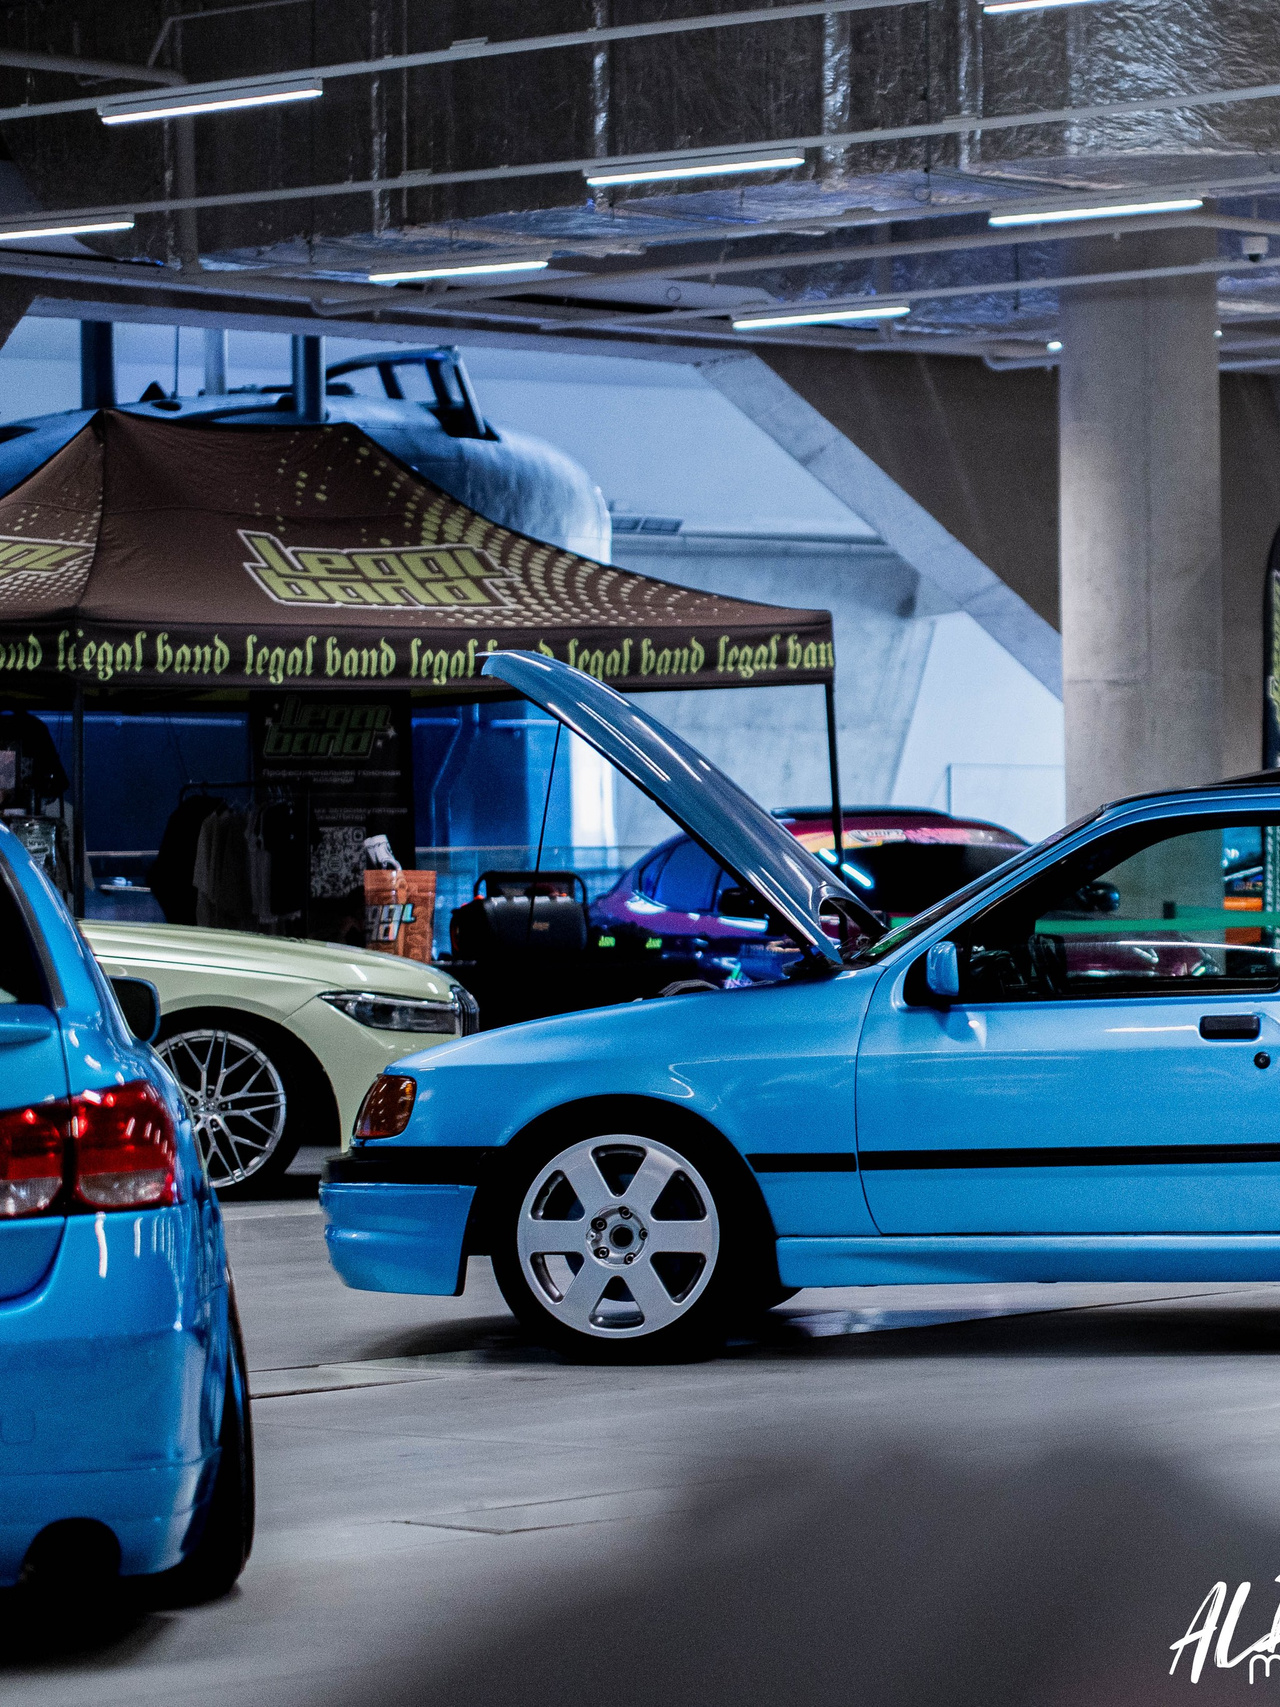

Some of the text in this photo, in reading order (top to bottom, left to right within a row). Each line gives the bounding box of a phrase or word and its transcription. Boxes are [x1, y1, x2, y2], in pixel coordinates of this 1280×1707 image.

[78, 629, 147, 681] egal
[156, 631, 230, 675] band
[244, 634, 318, 685] legal
[325, 636, 396, 677] band
[410, 637, 478, 685] legal
[641, 636, 705, 677] band
[718, 634, 781, 678] legal
[787, 634, 834, 669] ban
